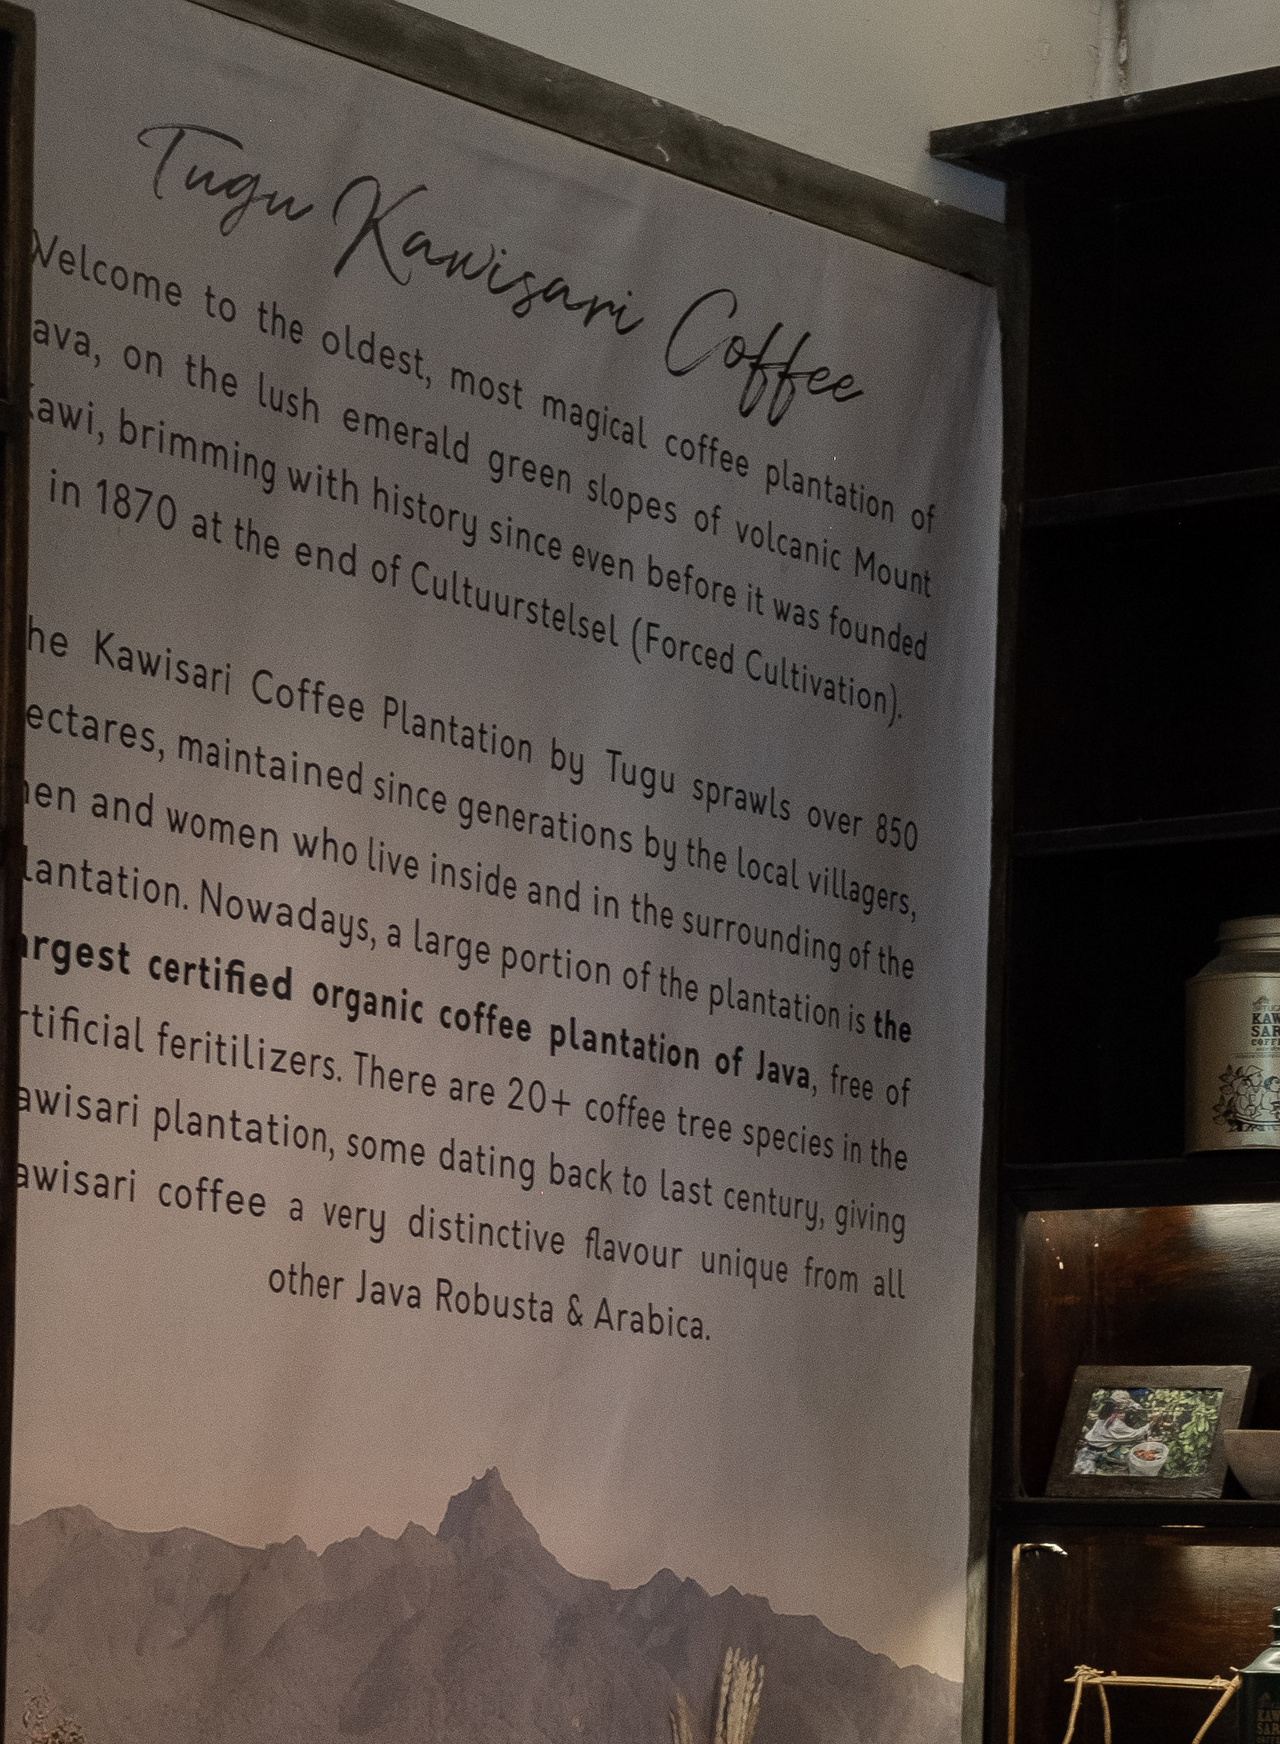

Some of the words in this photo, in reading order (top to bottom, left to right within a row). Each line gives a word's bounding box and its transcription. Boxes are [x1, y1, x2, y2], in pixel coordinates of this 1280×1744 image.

[138, 124, 314, 236] Tugu
[333, 175, 645, 337] Kawisari
[664, 288, 863, 427] Coffee
[32, 228, 182, 307] Welcome
[205, 285, 236, 323] to
[258, 301, 303, 345] the
[322, 325, 431, 389] oldest,
[451, 367, 522, 410] most
[543, 395, 647, 449] magical
[665, 433, 749, 477] coffee
[766, 459, 894, 522] plantation
[911, 503, 936, 534] of
[123, 345, 163, 377] on
[185, 354, 238, 397] the
[259, 372, 319, 423] lush
[343, 408, 469, 464] emerald
[488, 450, 571, 493] green
[587, 473, 677, 524] slopes
[694, 504, 721, 535] of
[736, 521, 841, 571] volcanic
[855, 546, 932, 598] Mount
[31, 383, 104, 445] awi,
[119, 408, 276, 495] brimming
[287, 465, 358, 505] with
[373, 476, 477, 547] history
[490, 516, 562, 560] since
[572, 544, 633, 581] even
[648, 554, 736, 607] before
[747, 583, 764, 616] it
[773, 598, 819, 630] was
[829, 605, 928, 661] founded
[50, 469, 80, 508] in
[97, 479, 177, 531] 1870
[192, 511, 222, 544] at
[234, 518, 280, 560] the
[295, 542, 356, 577] end
[371, 554, 401, 587] of
[411, 561, 619, 647] Cultuurstelsel
[632, 617, 734, 674] (Forced
[746, 649, 902, 728] Cultivation).
[95, 629, 231, 695] Kawisari
[252, 669, 364, 722] Coffee
[383, 695, 532, 763] Plantation
[551, 737, 584, 785] by
[606, 749, 674, 799] Tugu
[693, 778, 790, 821] sprawls
[807, 806, 863, 836] over
[876, 813, 918, 852] 850
[178, 735, 363, 795] maintained
[374, 772, 447, 814] since
[458, 796, 632, 853] generations
[645, 825, 676, 872] by
[687, 837, 727, 873] the
[738, 846, 799, 890] local
[808, 867, 916, 923] villagers,
[91, 793, 153, 827] and
[166, 807, 278, 853] women
[293, 826, 357, 866] who
[368, 837, 419, 880] live
[431, 853, 517, 900] inside
[528, 880, 580, 912] and
[594, 886, 619, 919] in
[631, 893, 673, 929] the
[683, 911, 841, 973] surrounding
[849, 940, 871, 970] of
[878, 945, 914, 980] the
[200, 879, 376, 950] Nowadays,
[387, 924, 401, 948] a
[414, 918, 490, 971] large
[502, 946, 610, 985] portion
[623, 960, 651, 992] of
[659, 966, 698, 1002] the
[709, 978, 839, 1028] plantation
[849, 1004, 865, 1034] is
[874, 1009, 912, 1043] the
[148, 955, 292, 1001] certified
[312, 982, 423, 1024] organic
[439, 1001, 531, 1042] coffee
[550, 1016, 699, 1070] plantation
[715, 1045, 744, 1077] of
[756, 1050, 817, 1096] Java,
[831, 1064, 873, 1101] free
[886, 1077, 911, 1107] of
[157, 1021, 341, 1082] feritilizers.
[354, 1051, 436, 1097] There
[449, 1077, 495, 1106] are
[508, 1077, 571, 1116] 20+
[585, 1093, 665, 1132] coffee
[678, 1107, 732, 1142] tree
[743, 1124, 833, 1159] species
[844, 1133, 861, 1163] in
[870, 1138, 908, 1171] the
[158, 1176, 266, 1217] coffee
[289, 1198, 303, 1221] a
[323, 1202, 385, 1244] very
[408, 1205, 565, 1255] distinctive
[585, 1226, 682, 1269] flavour
[702, 1248, 788, 1289] unique
[805, 1256, 858, 1293] from
[874, 1268, 905, 1299] all
[268, 1262, 344, 1300] other
[356, 1270, 421, 1309] Java
[436, 1278, 553, 1323] Robusta
[567, 1293, 583, 1326] &
[594, 1297, 710, 1340] Arabica.
